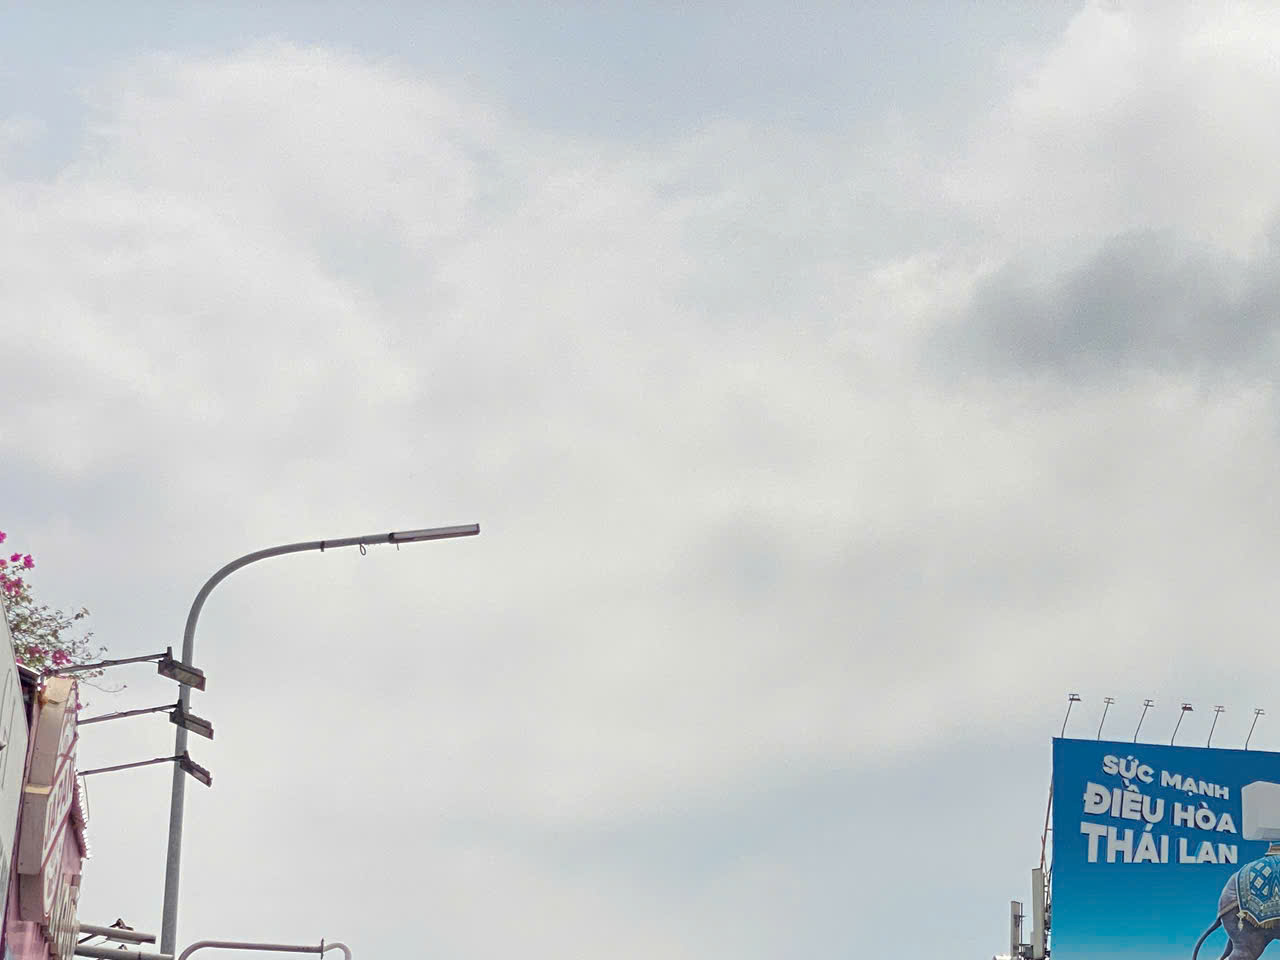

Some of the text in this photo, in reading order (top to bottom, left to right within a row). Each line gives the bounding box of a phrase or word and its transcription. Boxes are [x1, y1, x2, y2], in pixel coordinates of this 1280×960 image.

[1102, 755, 1229, 800] SỨC MẠNH
[1083, 779, 1237, 834] ĐIỀU HÒA
[1080, 822, 1238, 864] THÁI LAN
